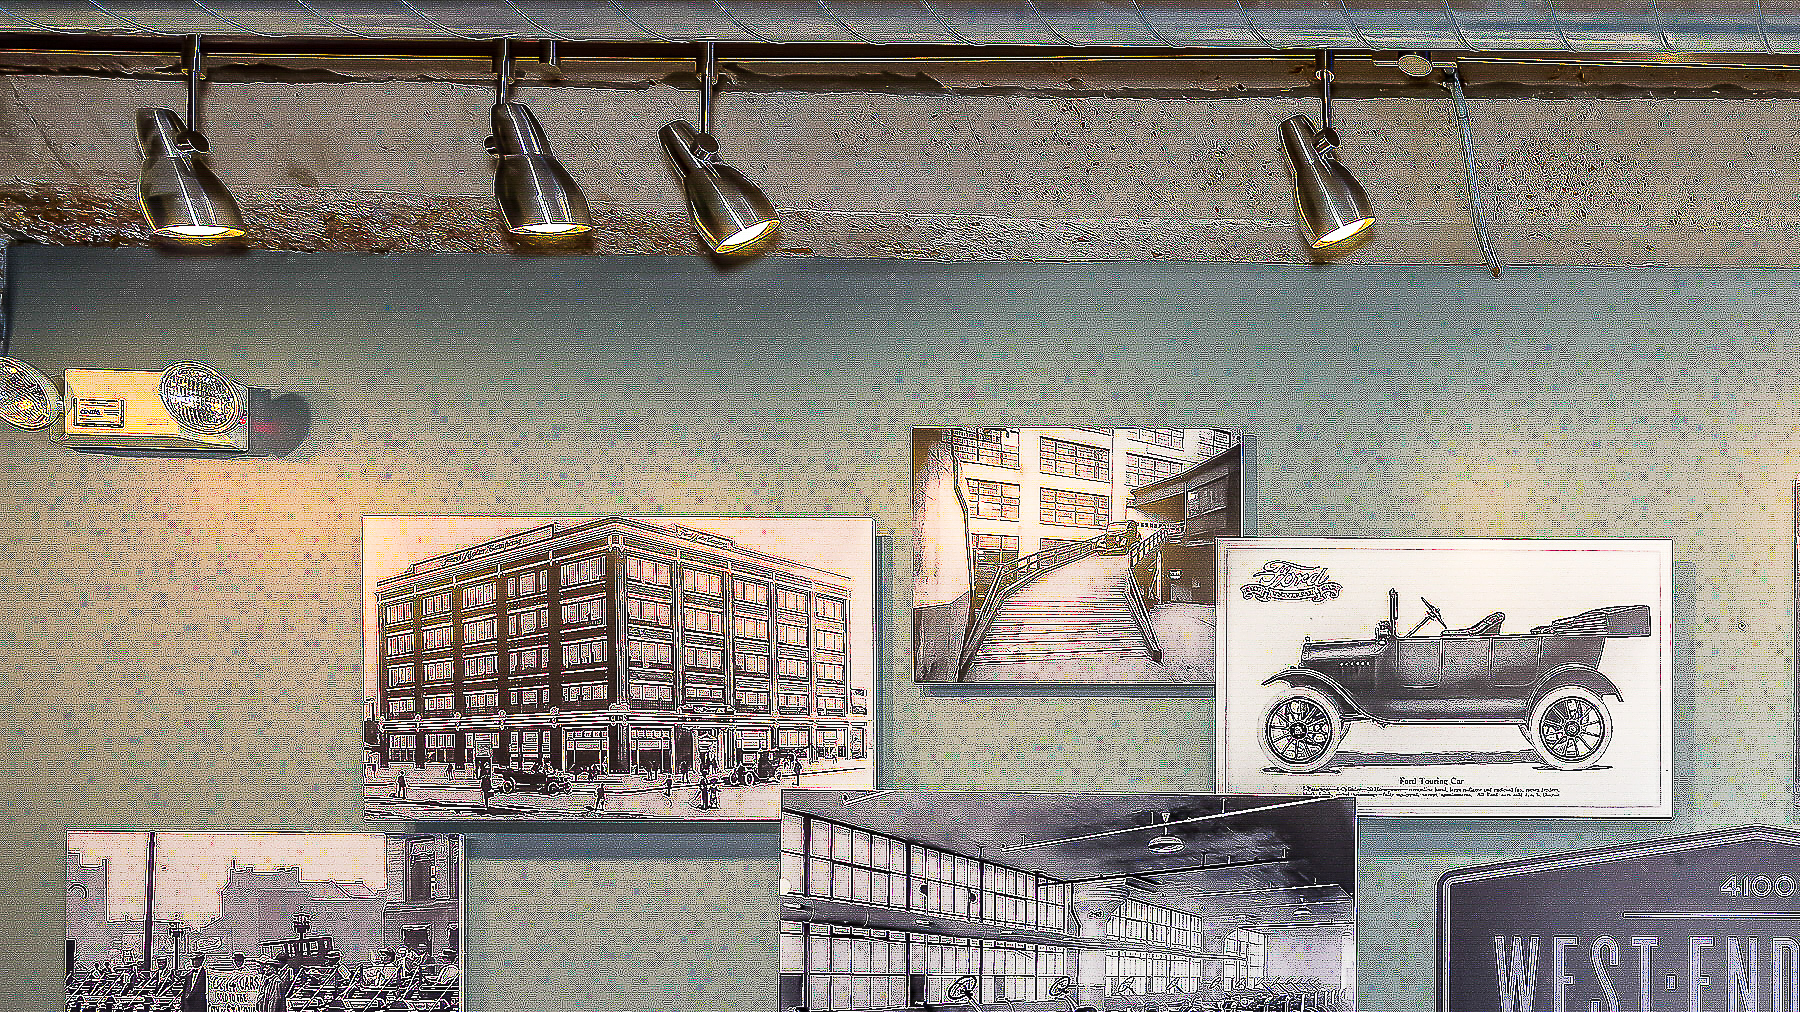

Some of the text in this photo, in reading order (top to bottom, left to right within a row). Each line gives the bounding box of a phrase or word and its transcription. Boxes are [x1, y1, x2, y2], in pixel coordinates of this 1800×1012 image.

[1253, 559, 1330, 588] Ford
[1399, 777, 1465, 786] Ford Touring Car
[1719, 874, 1798, 898] 4100
